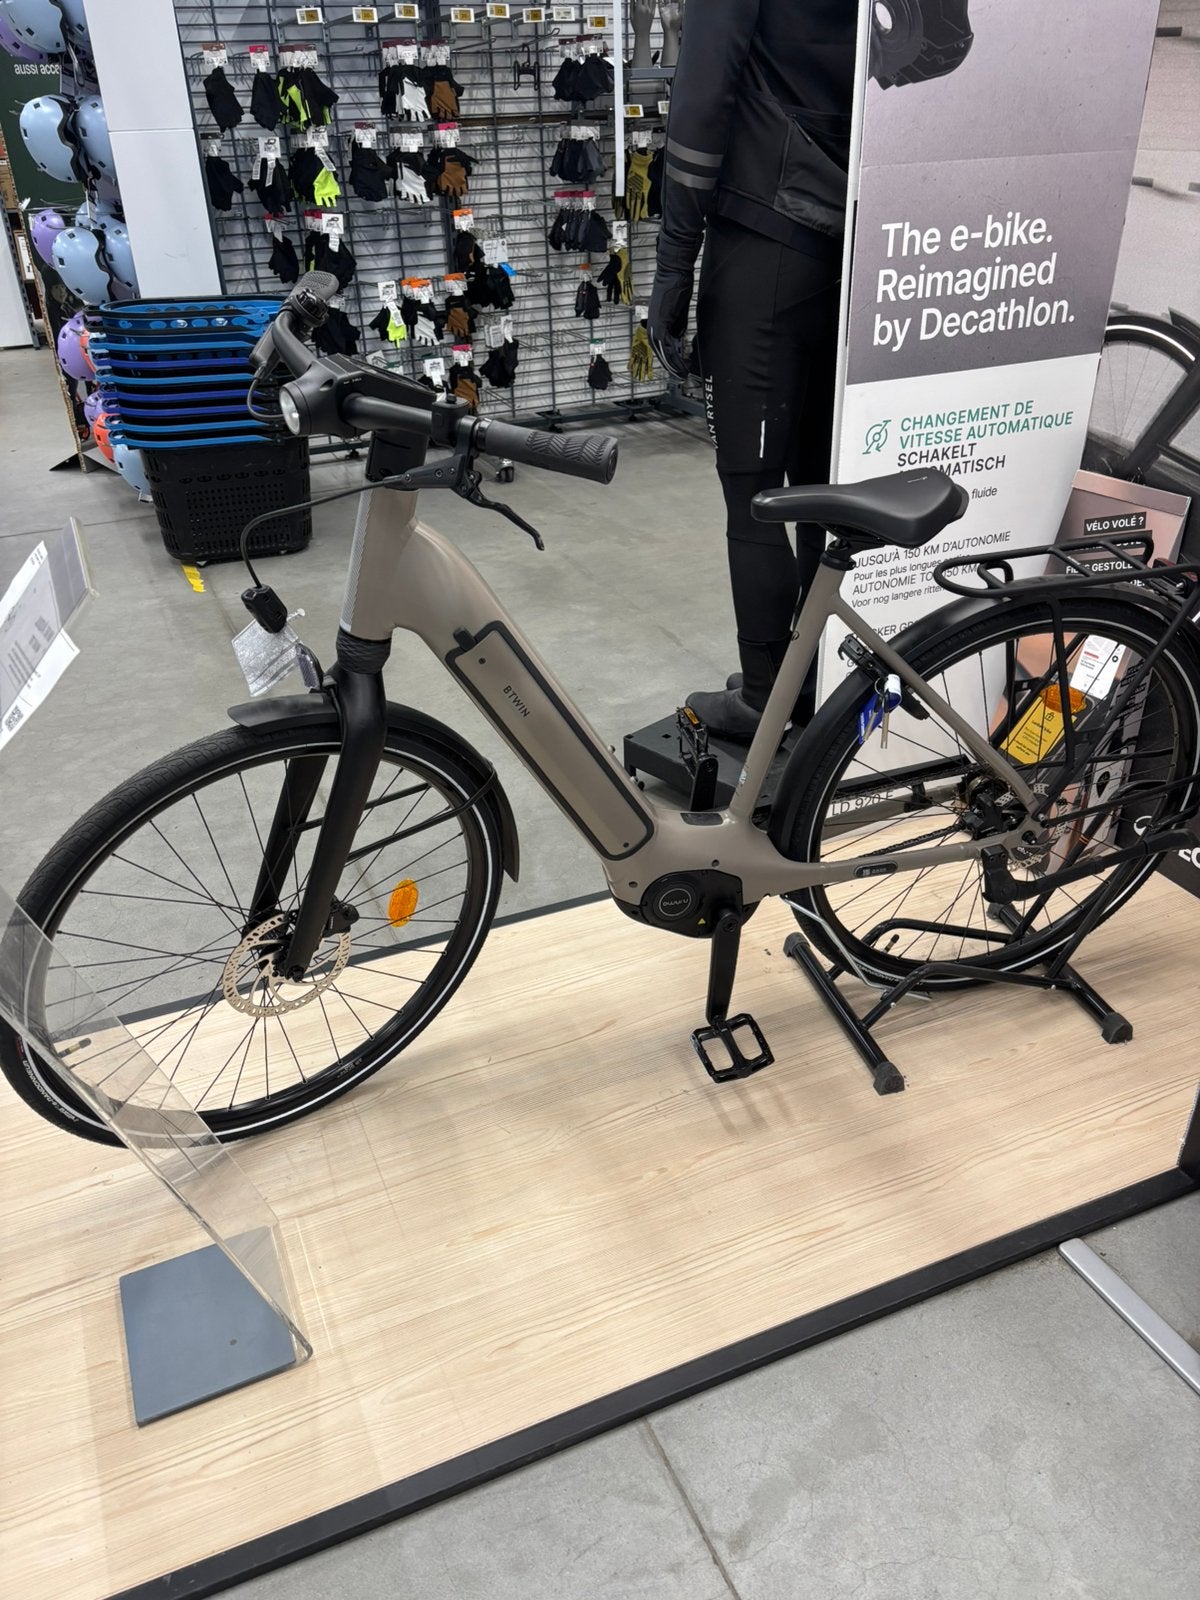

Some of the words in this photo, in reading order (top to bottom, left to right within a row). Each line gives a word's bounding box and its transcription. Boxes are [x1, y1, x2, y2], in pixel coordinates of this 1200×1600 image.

[882, 219, 940, 258] The
[950, 211, 1053, 251] e-bike.
[876, 252, 1057, 303] Reimagined
[873, 313, 912, 353] by
[919, 296, 1075, 341] Decathlon.
[704, 375, 714, 420] RYSEL
[899, 428, 963, 450] VITESSE
[966, 411, 1074, 440] AUTOMATIQUE
[901, 403, 1010, 432] CHANGEMENT
[1014, 400, 1035, 415] DE
[897, 443, 977, 467] SCHAKELT
[971, 486, 998, 499] fluide
[1086, 520, 1110, 532] VÉLO
[1111, 515, 1136, 529] VOLÉ
[1138, 516, 1145, 526] ?
[904, 546, 921, 560] 150
[923, 543, 940, 556] KM
[942, 531, 1012, 553] D'AUTONOMIE
[852, 574, 916, 595] AUTONOMIE
[853, 570, 873, 582] Pour
[875, 567, 888, 578] les
[889, 566, 907, 578] plus
[909, 559, 942, 574] longues
[851, 597, 871, 608] Voor
[873, 595, 889, 605] nog
[891, 587, 922, 601] langere
[503, 685, 530, 718] BTWIN
